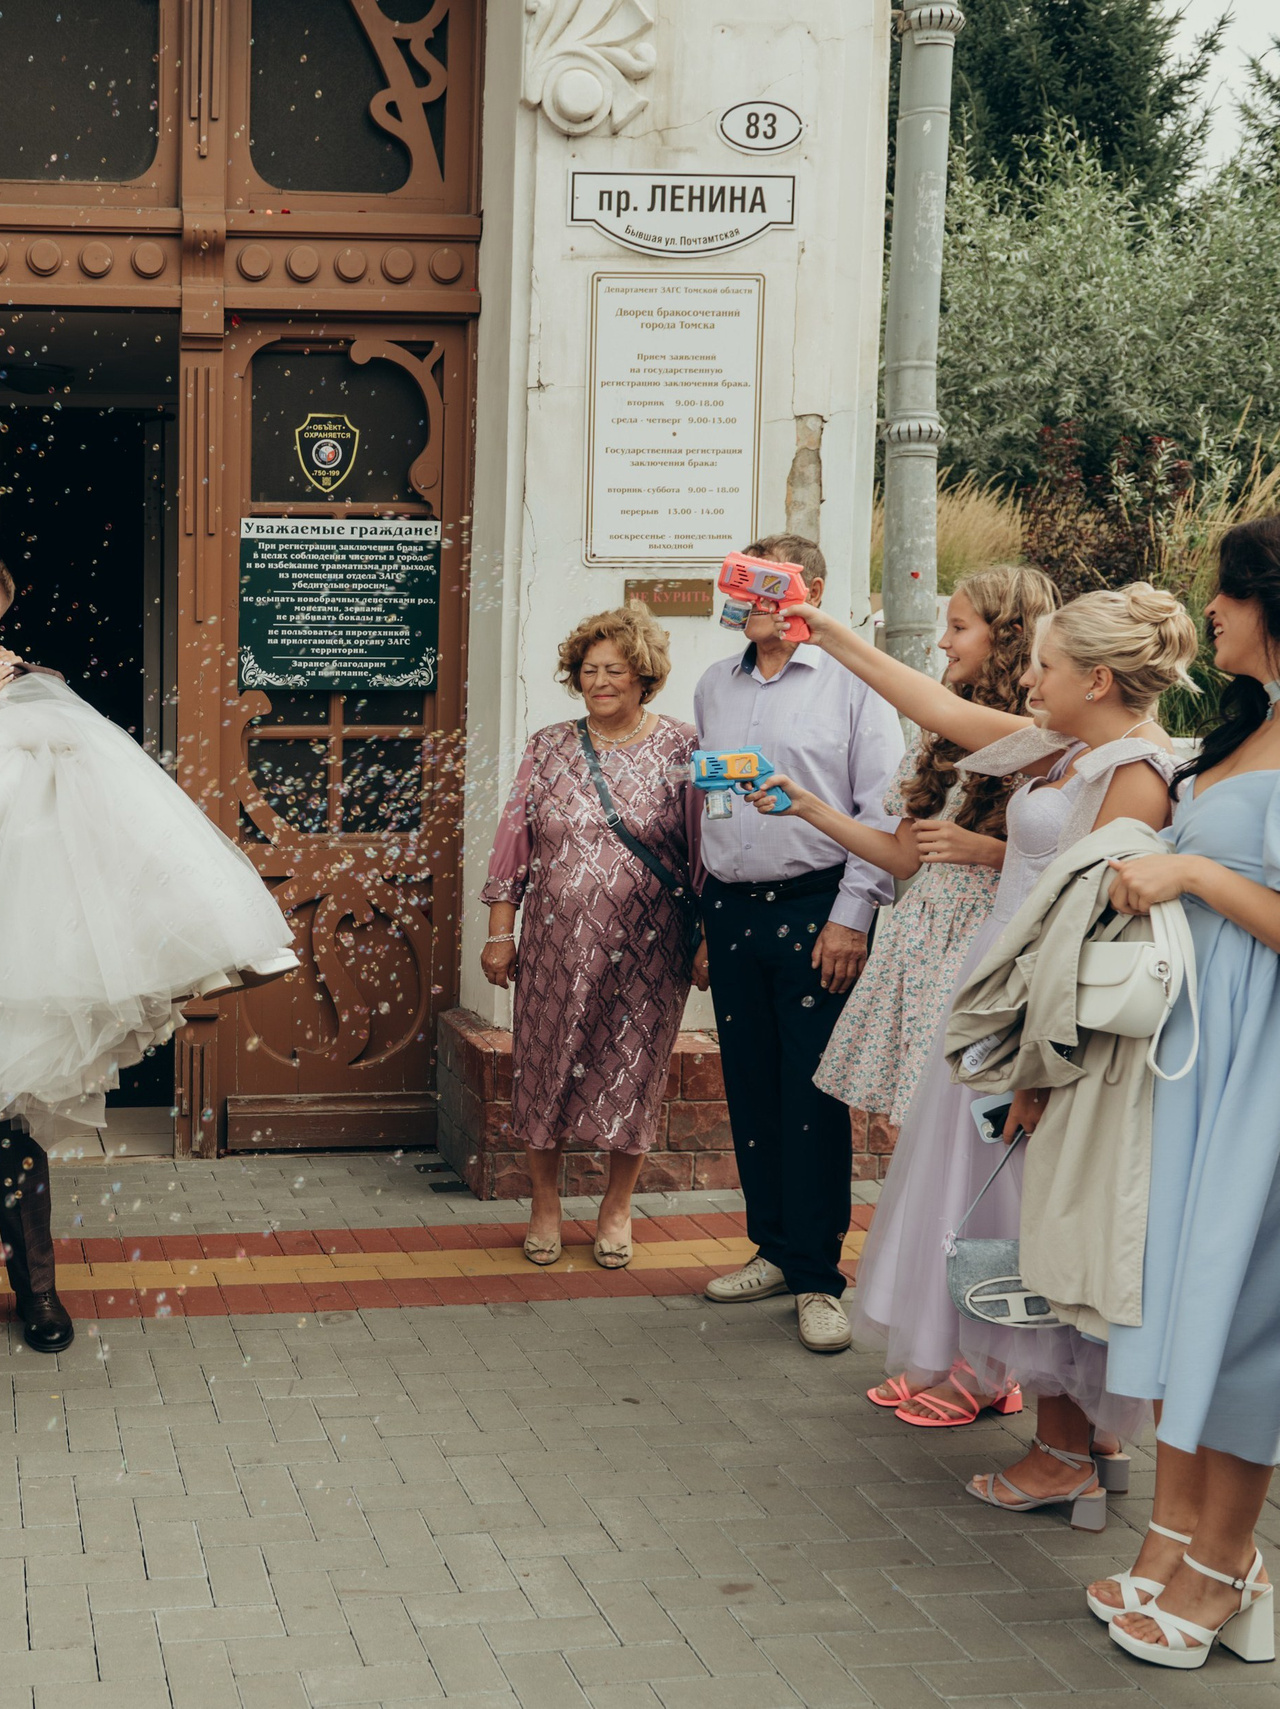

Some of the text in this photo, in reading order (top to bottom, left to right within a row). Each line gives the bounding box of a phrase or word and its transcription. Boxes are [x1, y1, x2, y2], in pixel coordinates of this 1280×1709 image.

[745, 112, 777, 140] 83
[598, 185, 767, 218] пр. ЛЕНИНА
[624, 224, 741, 247] Бывшая ул. Почтамтская
[615, 307, 740, 318] Дворец бракосочетаний
[640, 321, 715, 330] города Томска
[669, 353, 716, 361] заявлений
[721, 380, 751, 388] брака.
[605, 447, 683, 455] Государственная
[688, 459, 718, 468] брака:
[244, 522, 439, 538] Уважаемые граждане!
[261, 552, 288, 560] целях
[292, 572, 344, 580] помещения
[292, 581, 349, 591] убедительно
[653, 591, 710, 602] КУРИТЬ
[311, 647, 367, 655] территории.
[332, 660, 386, 669] благодарим
